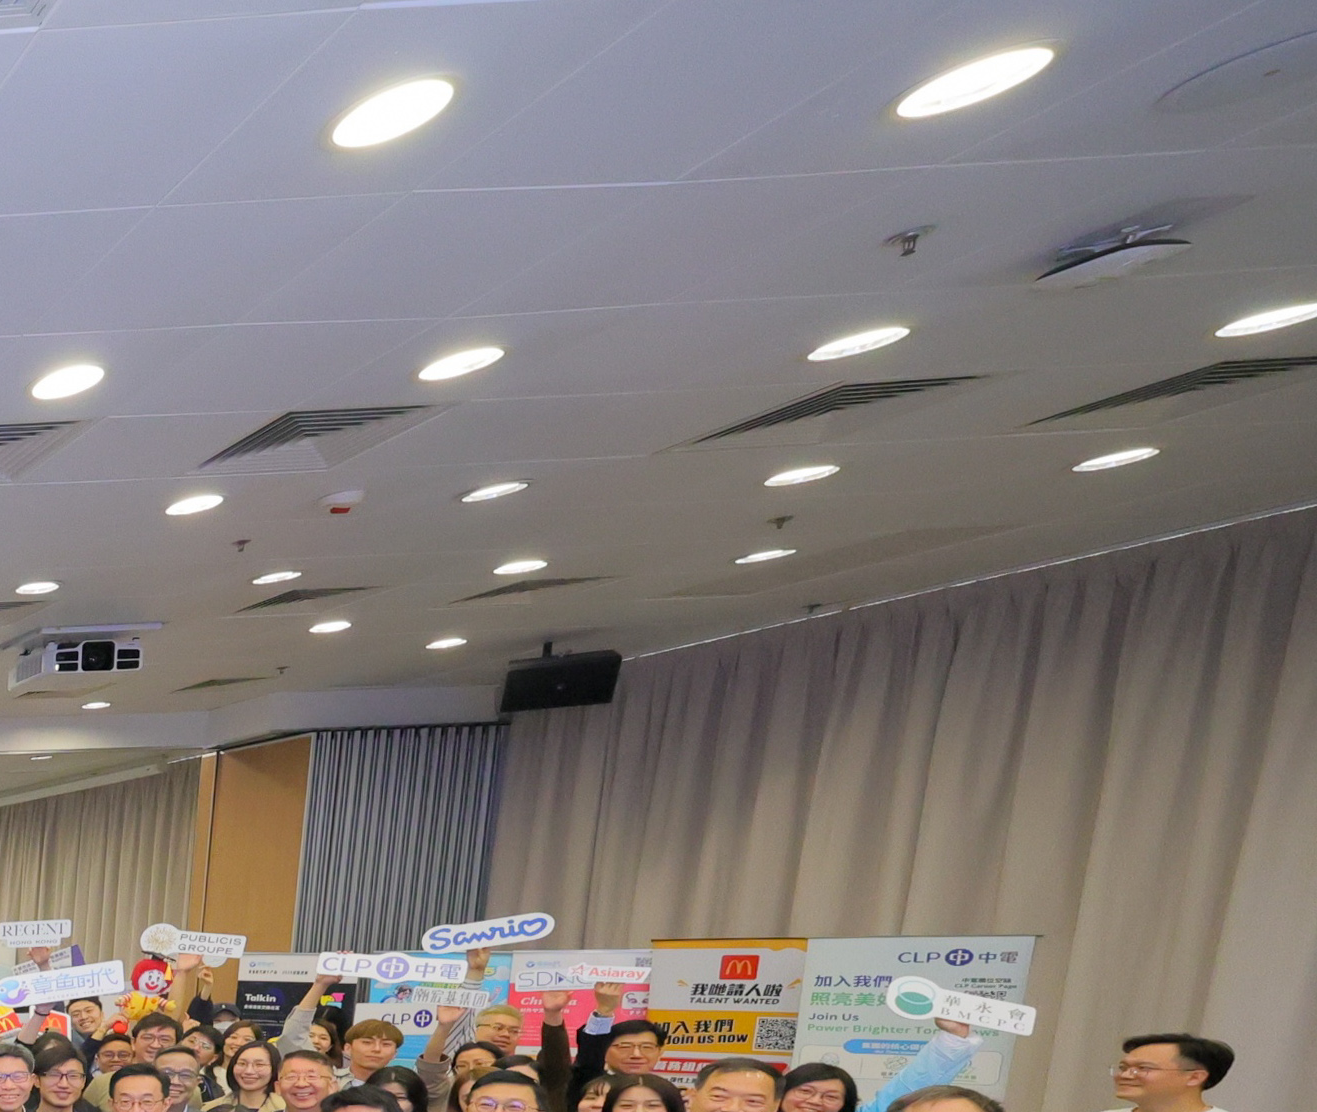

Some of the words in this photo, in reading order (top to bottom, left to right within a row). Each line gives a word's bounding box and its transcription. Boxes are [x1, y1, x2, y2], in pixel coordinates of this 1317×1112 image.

[2, 923, 68, 937] REGENT
[179, 933, 242, 946] PUBLICIS
[178, 944, 234, 955] GROUPE
[898, 951, 940, 964] CLP
[978, 951, 1018, 964] 中電
[322, 957, 371, 974] CLP
[415, 962, 460, 981] 中電
[588, 967, 645, 980] Asiaray
[815, 975, 892, 988] 加入我們
[690, 983, 783, 998] 我哋請人啦
[245, 993, 277, 1003] Talkin
[731, 997, 779, 1005] WANTED
[809, 1013, 839, 1022] Join
[842, 1013, 859, 1022] Us
[807, 1023, 851, 1034] Power
[854, 1023, 910, 1035] Brighter
[696, 1036, 714, 1044] us
[717, 1033, 748, 1043] now
